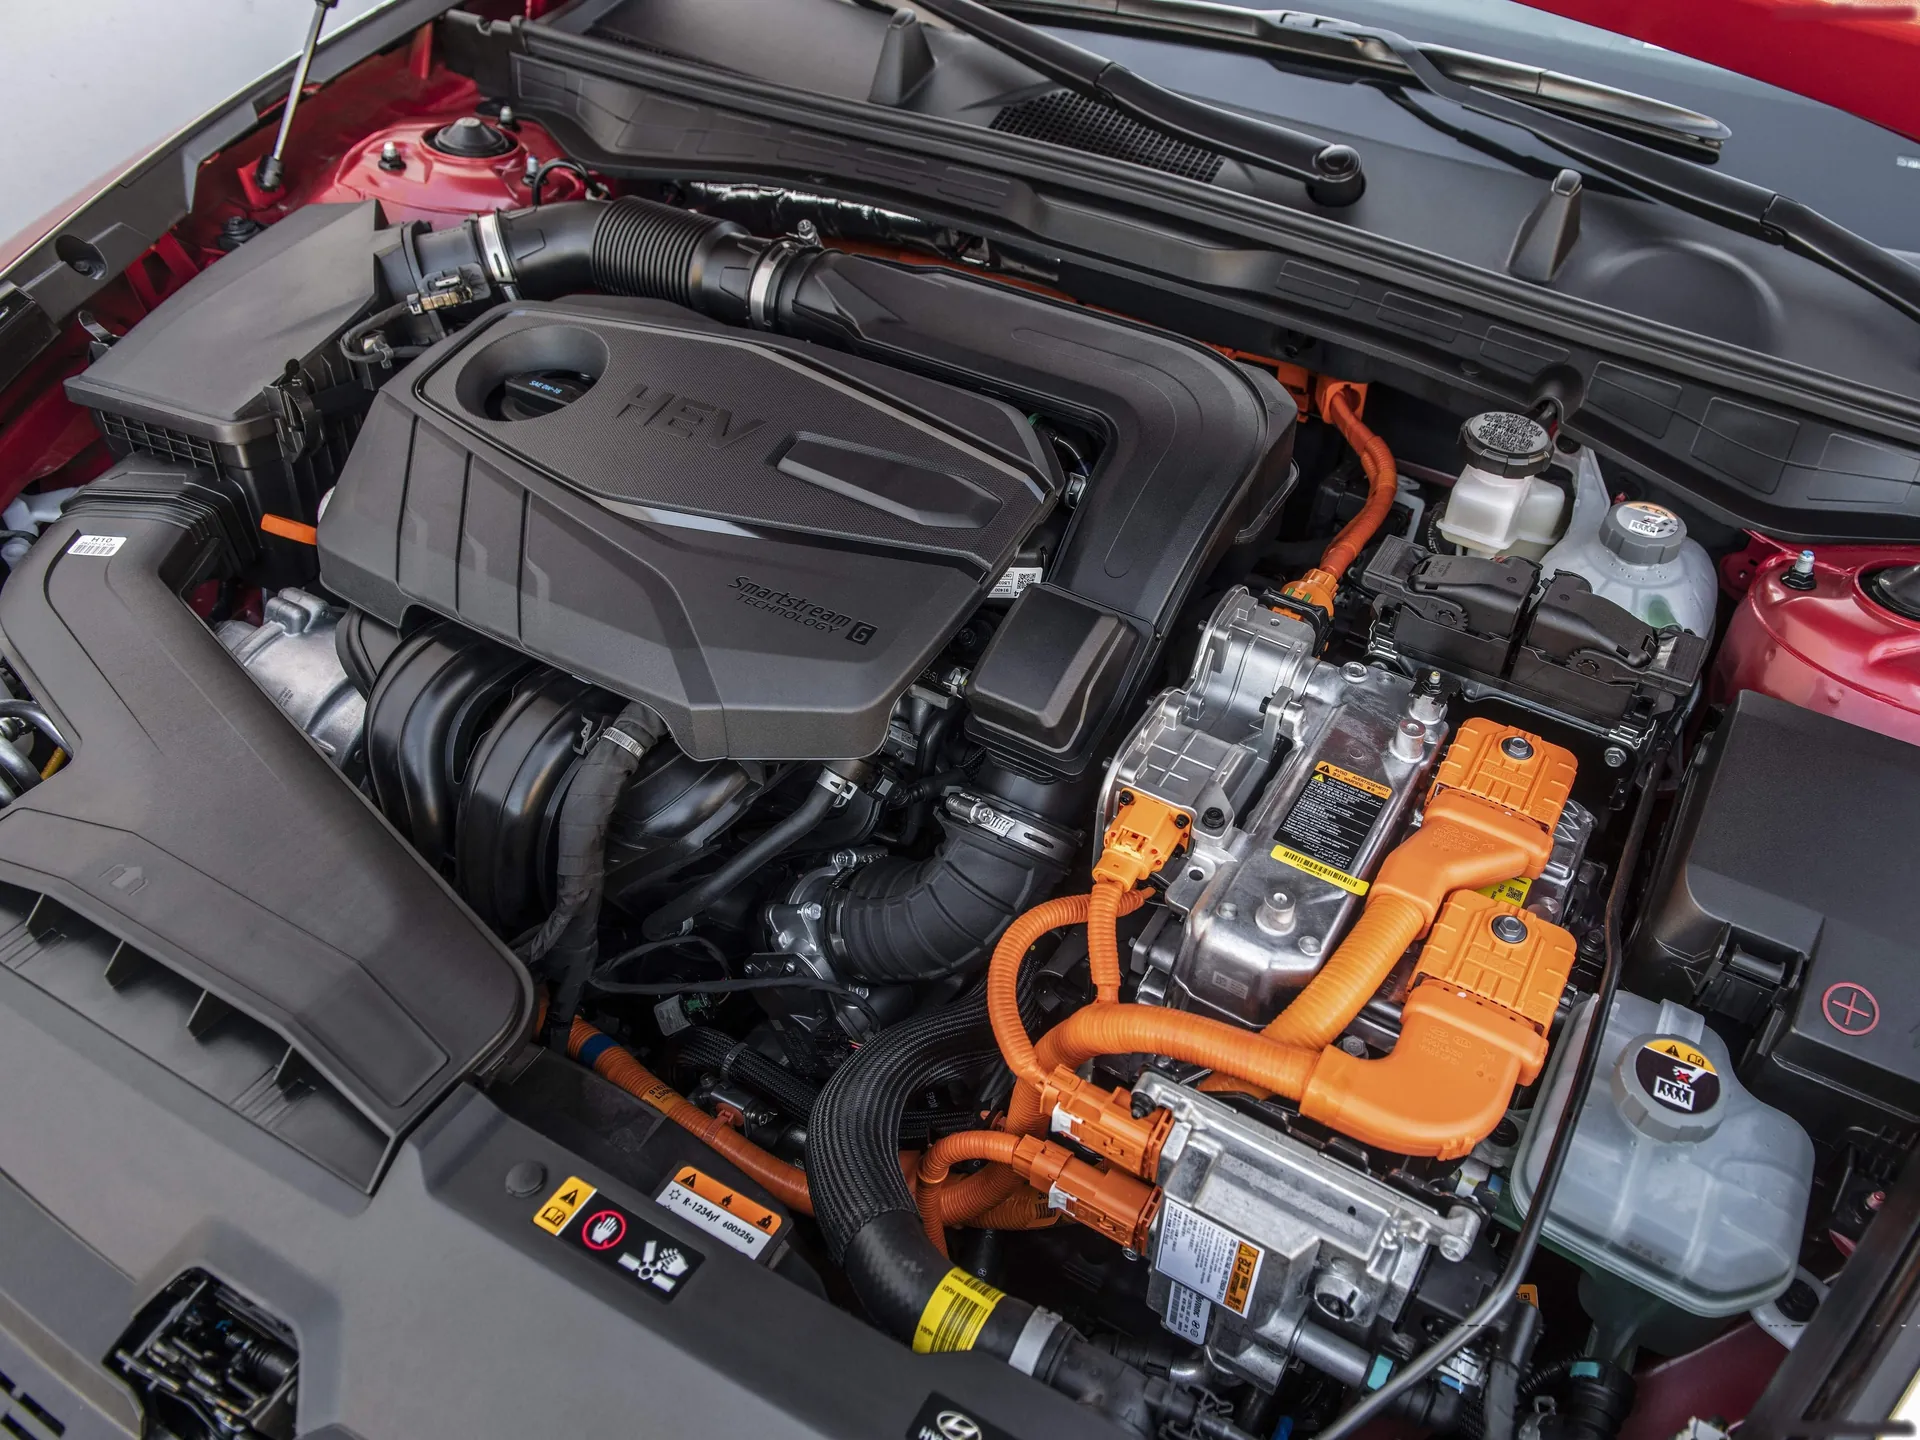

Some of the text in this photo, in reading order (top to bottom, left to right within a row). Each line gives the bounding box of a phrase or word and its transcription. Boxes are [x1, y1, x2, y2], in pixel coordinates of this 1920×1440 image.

[609, 383, 769, 449] HEV
[728, 575, 852, 627] Smartstream
[737, 592, 841, 634] TECHNOLOGY
[681, 1197, 756, 1245] R-1234yf 600±25g
